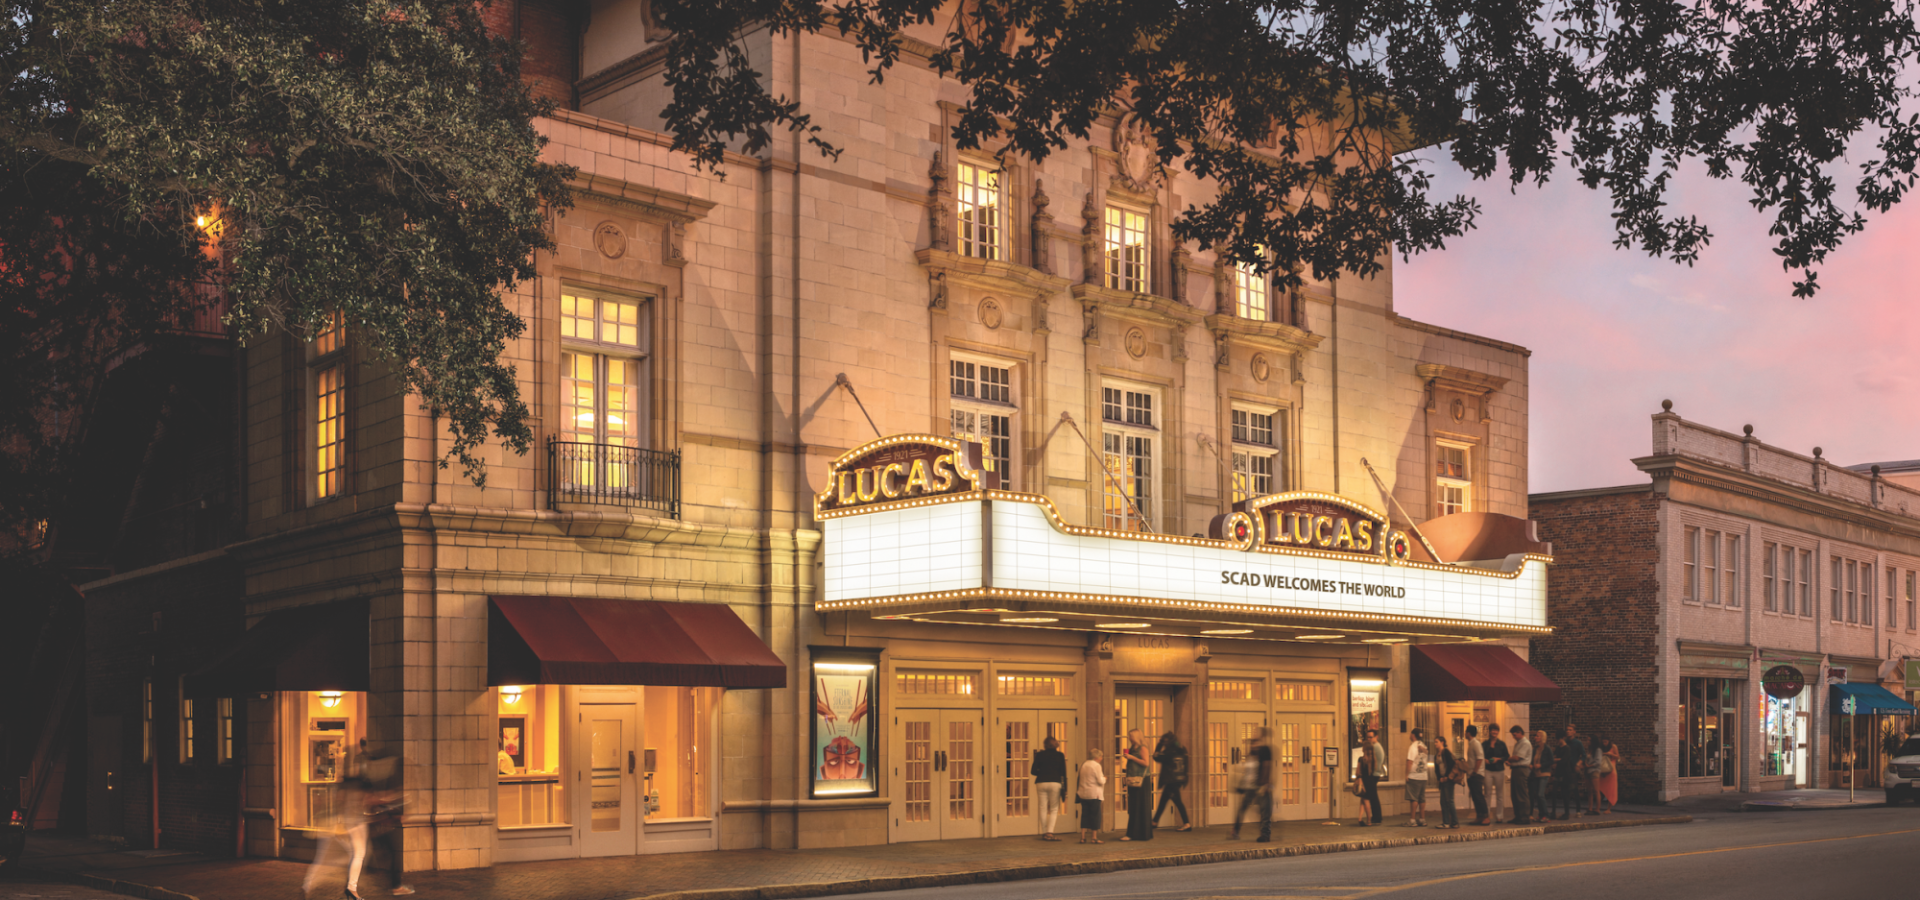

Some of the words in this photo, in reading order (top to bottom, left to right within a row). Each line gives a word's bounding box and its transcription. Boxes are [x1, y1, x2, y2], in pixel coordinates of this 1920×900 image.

[893, 450, 908, 460] 1921
[836, 454, 956, 505] LUCAS
[1311, 504, 1323, 514] 1921
[1269, 509, 1374, 551] LUCAS
[1221, 570, 1261, 587] SCAD
[1263, 574, 1337, 594] WELCOMES
[1338, 581, 1362, 595] THE
[1363, 583, 1406, 599] WORLD
[1138, 637, 1170, 649] LUCAS
